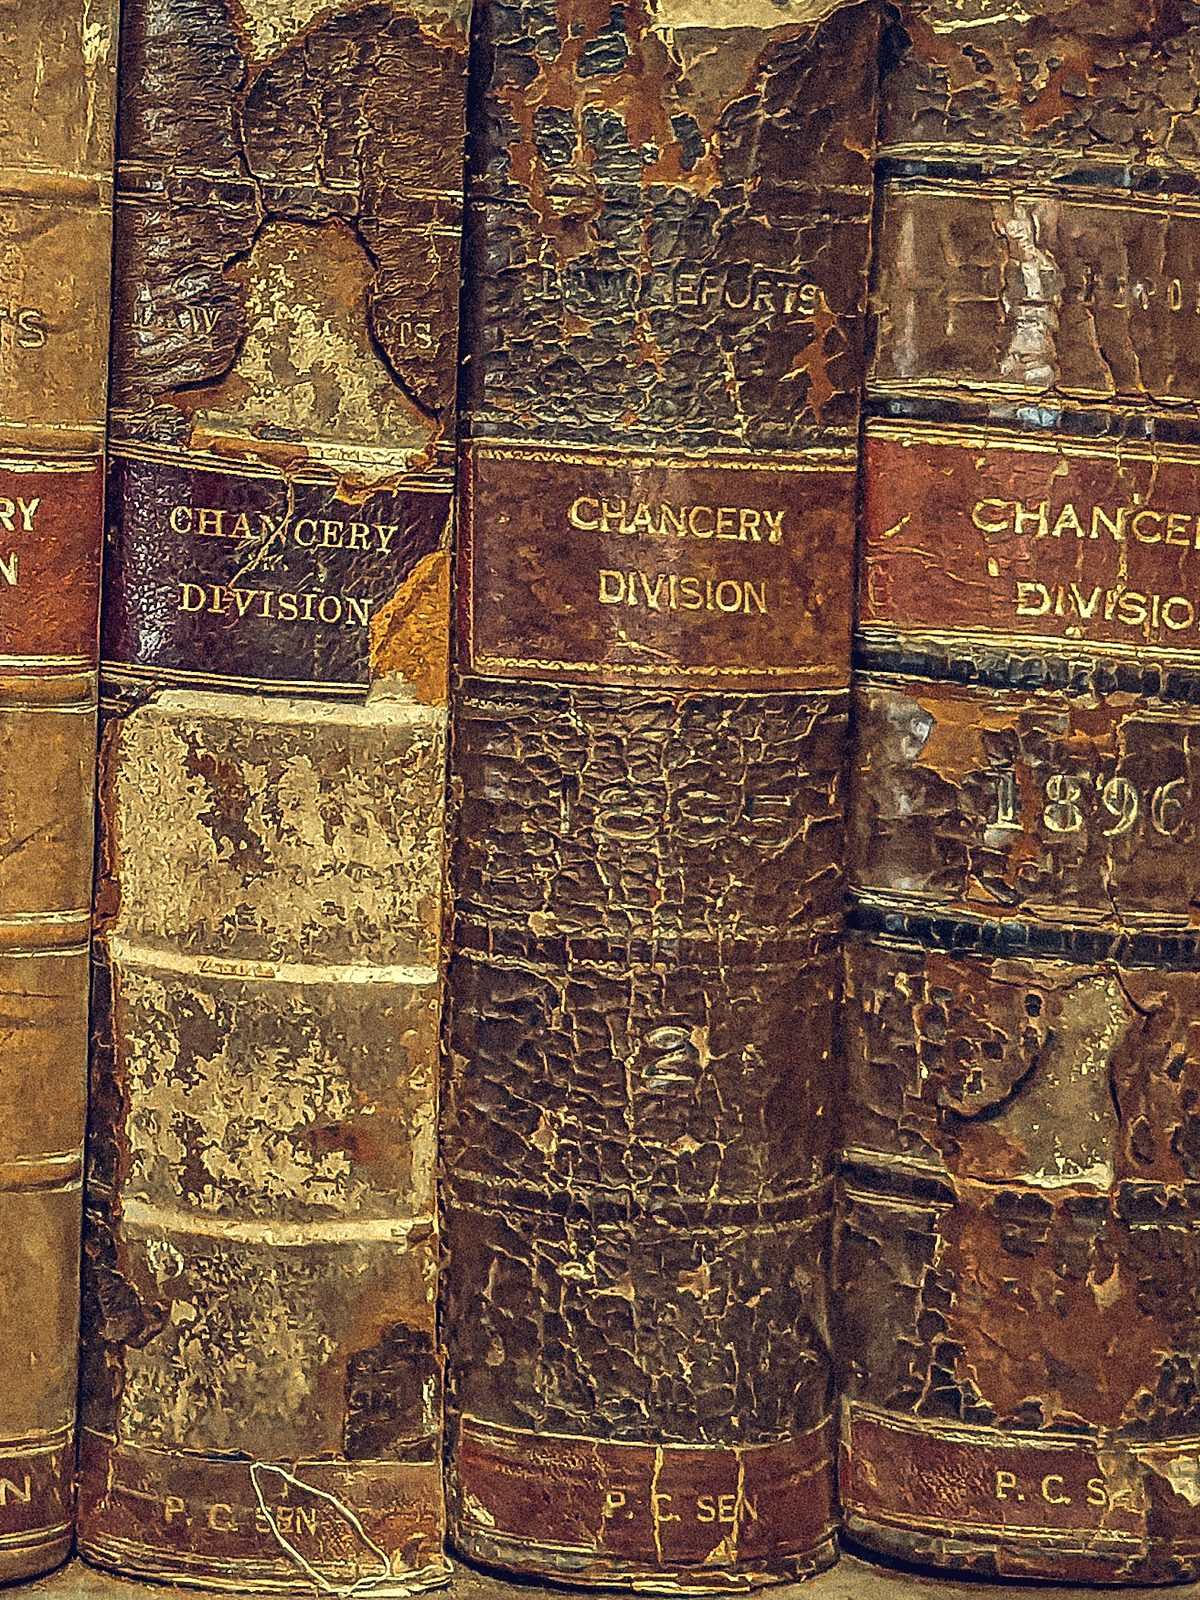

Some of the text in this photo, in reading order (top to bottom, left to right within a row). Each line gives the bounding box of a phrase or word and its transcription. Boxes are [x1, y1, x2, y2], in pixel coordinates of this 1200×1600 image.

[168, 504, 399, 554] CHANCERY
[566, 496, 786, 546] CHANCERY
[177, 582, 373, 628] DIVISION
[598, 568, 768, 615] DIVISION
[1014, 580, 1200, 633] DIVISIO
[984, 768, 1187, 838] 1896
[640, 1025, 697, 1088] 2
[255, 1504, 318, 1536] SEN
[697, 1494, 758, 1524] SEN
